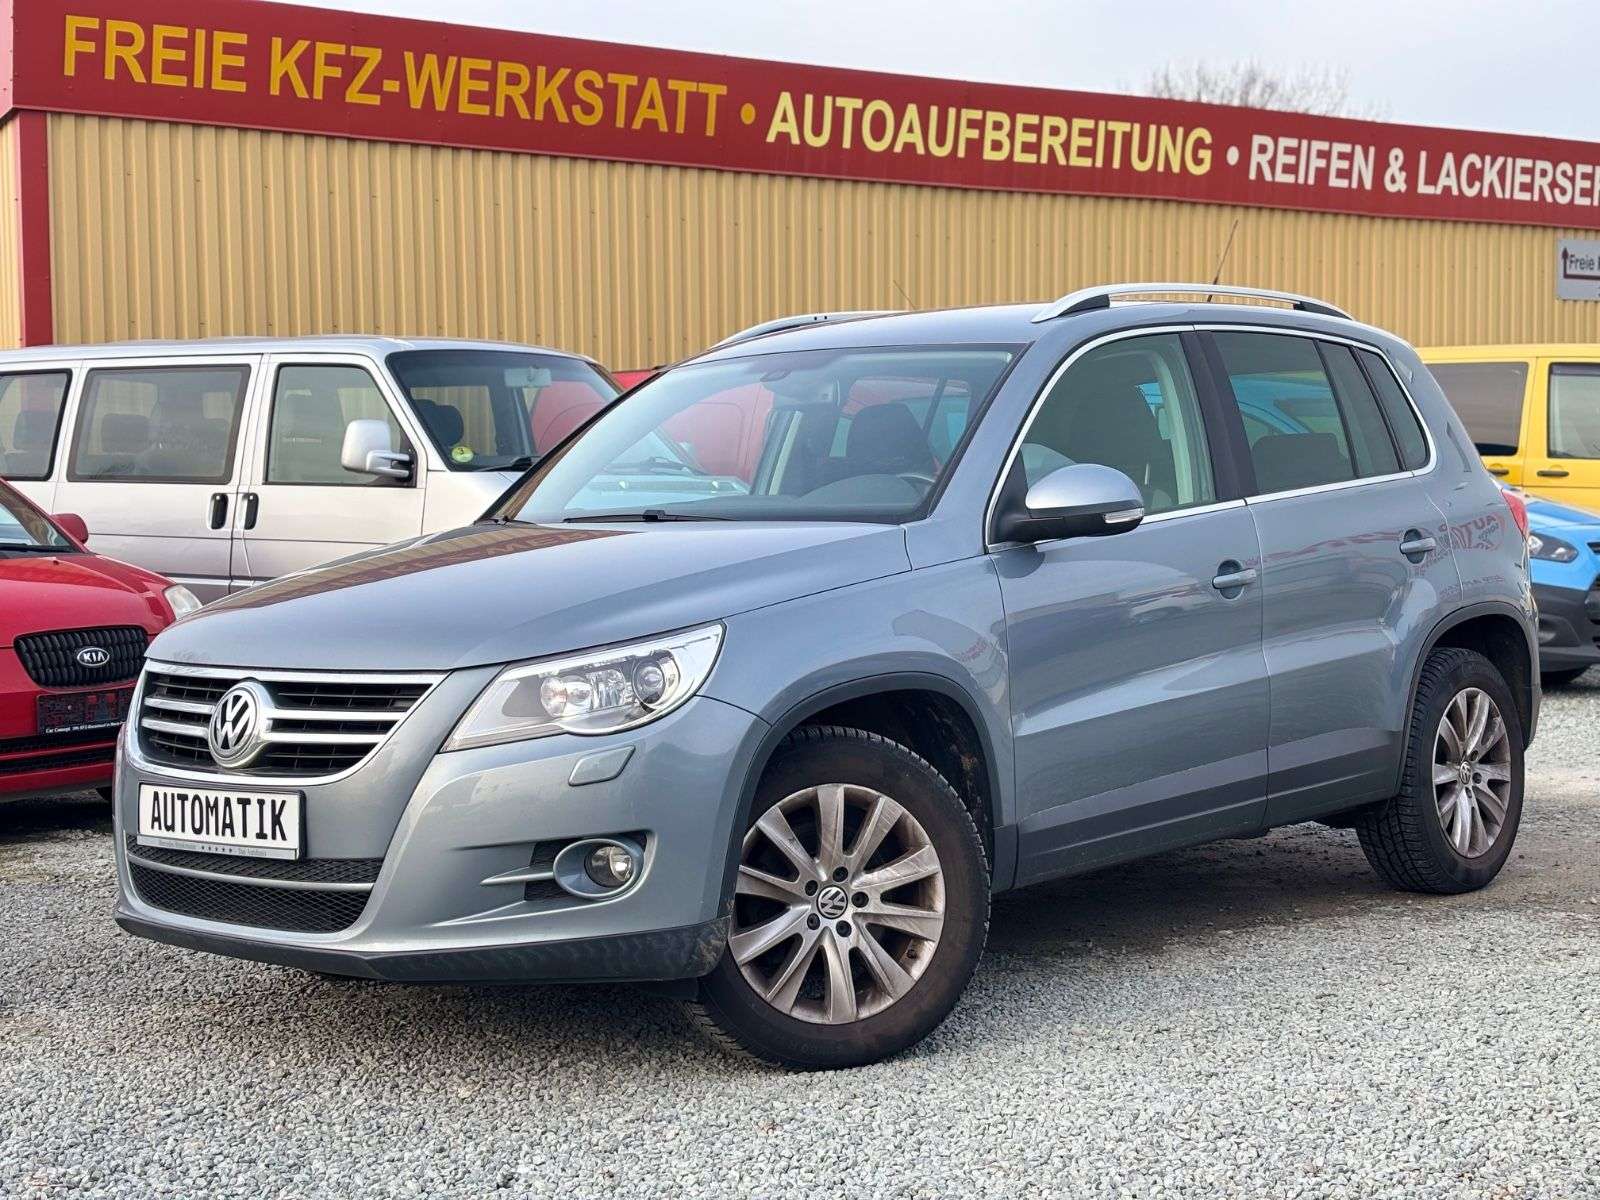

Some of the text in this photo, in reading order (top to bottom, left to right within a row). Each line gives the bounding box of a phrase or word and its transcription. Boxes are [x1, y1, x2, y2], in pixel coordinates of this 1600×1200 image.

[64, 15, 247, 92] FREIE
[270, 37, 727, 136] KFZ-WERKSTATT
[766, 92, 1212, 175] AUTOAUFBEREITUNG
[1249, 135, 1375, 190] REIFEN
[1384, 148, 1407, 192] &
[1569, 253, 1595, 270] Freie
[151, 790, 288, 841] AUTOMATIK
